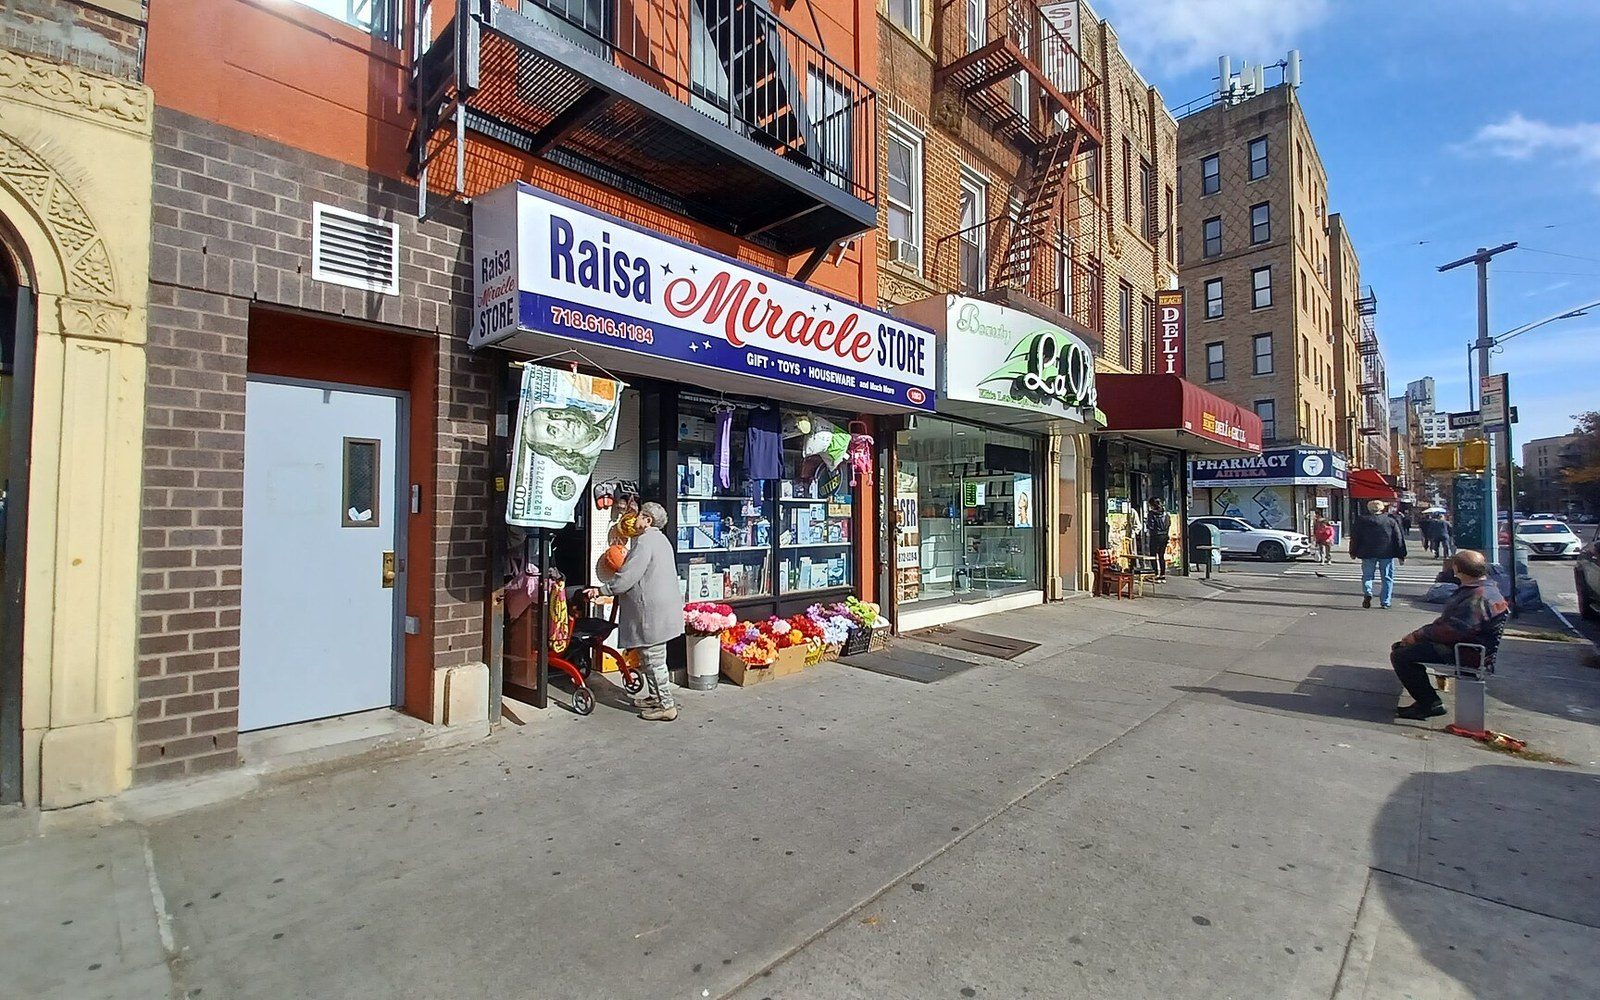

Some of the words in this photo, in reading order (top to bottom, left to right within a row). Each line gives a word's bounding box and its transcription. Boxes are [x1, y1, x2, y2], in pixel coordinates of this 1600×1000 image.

[481, 249, 511, 285] Raisa
[478, 275, 516, 308] Miracle
[550, 214, 652, 304] Raisa
[664, 271, 874, 364] Miracle
[877, 323, 925, 377] STORE
[479, 297, 514, 338] STORE
[550, 306, 654, 344] 718.616.1184
[746, 352, 769, 369] GIFT
[777, 358, 801, 376] TOYS
[808, 366, 856, 388] HOUSEWARE
[1457, 416, 1478, 424] ONE
[1196, 454, 1290, 470] PHARMACY
[512, 485, 527, 517] 100
